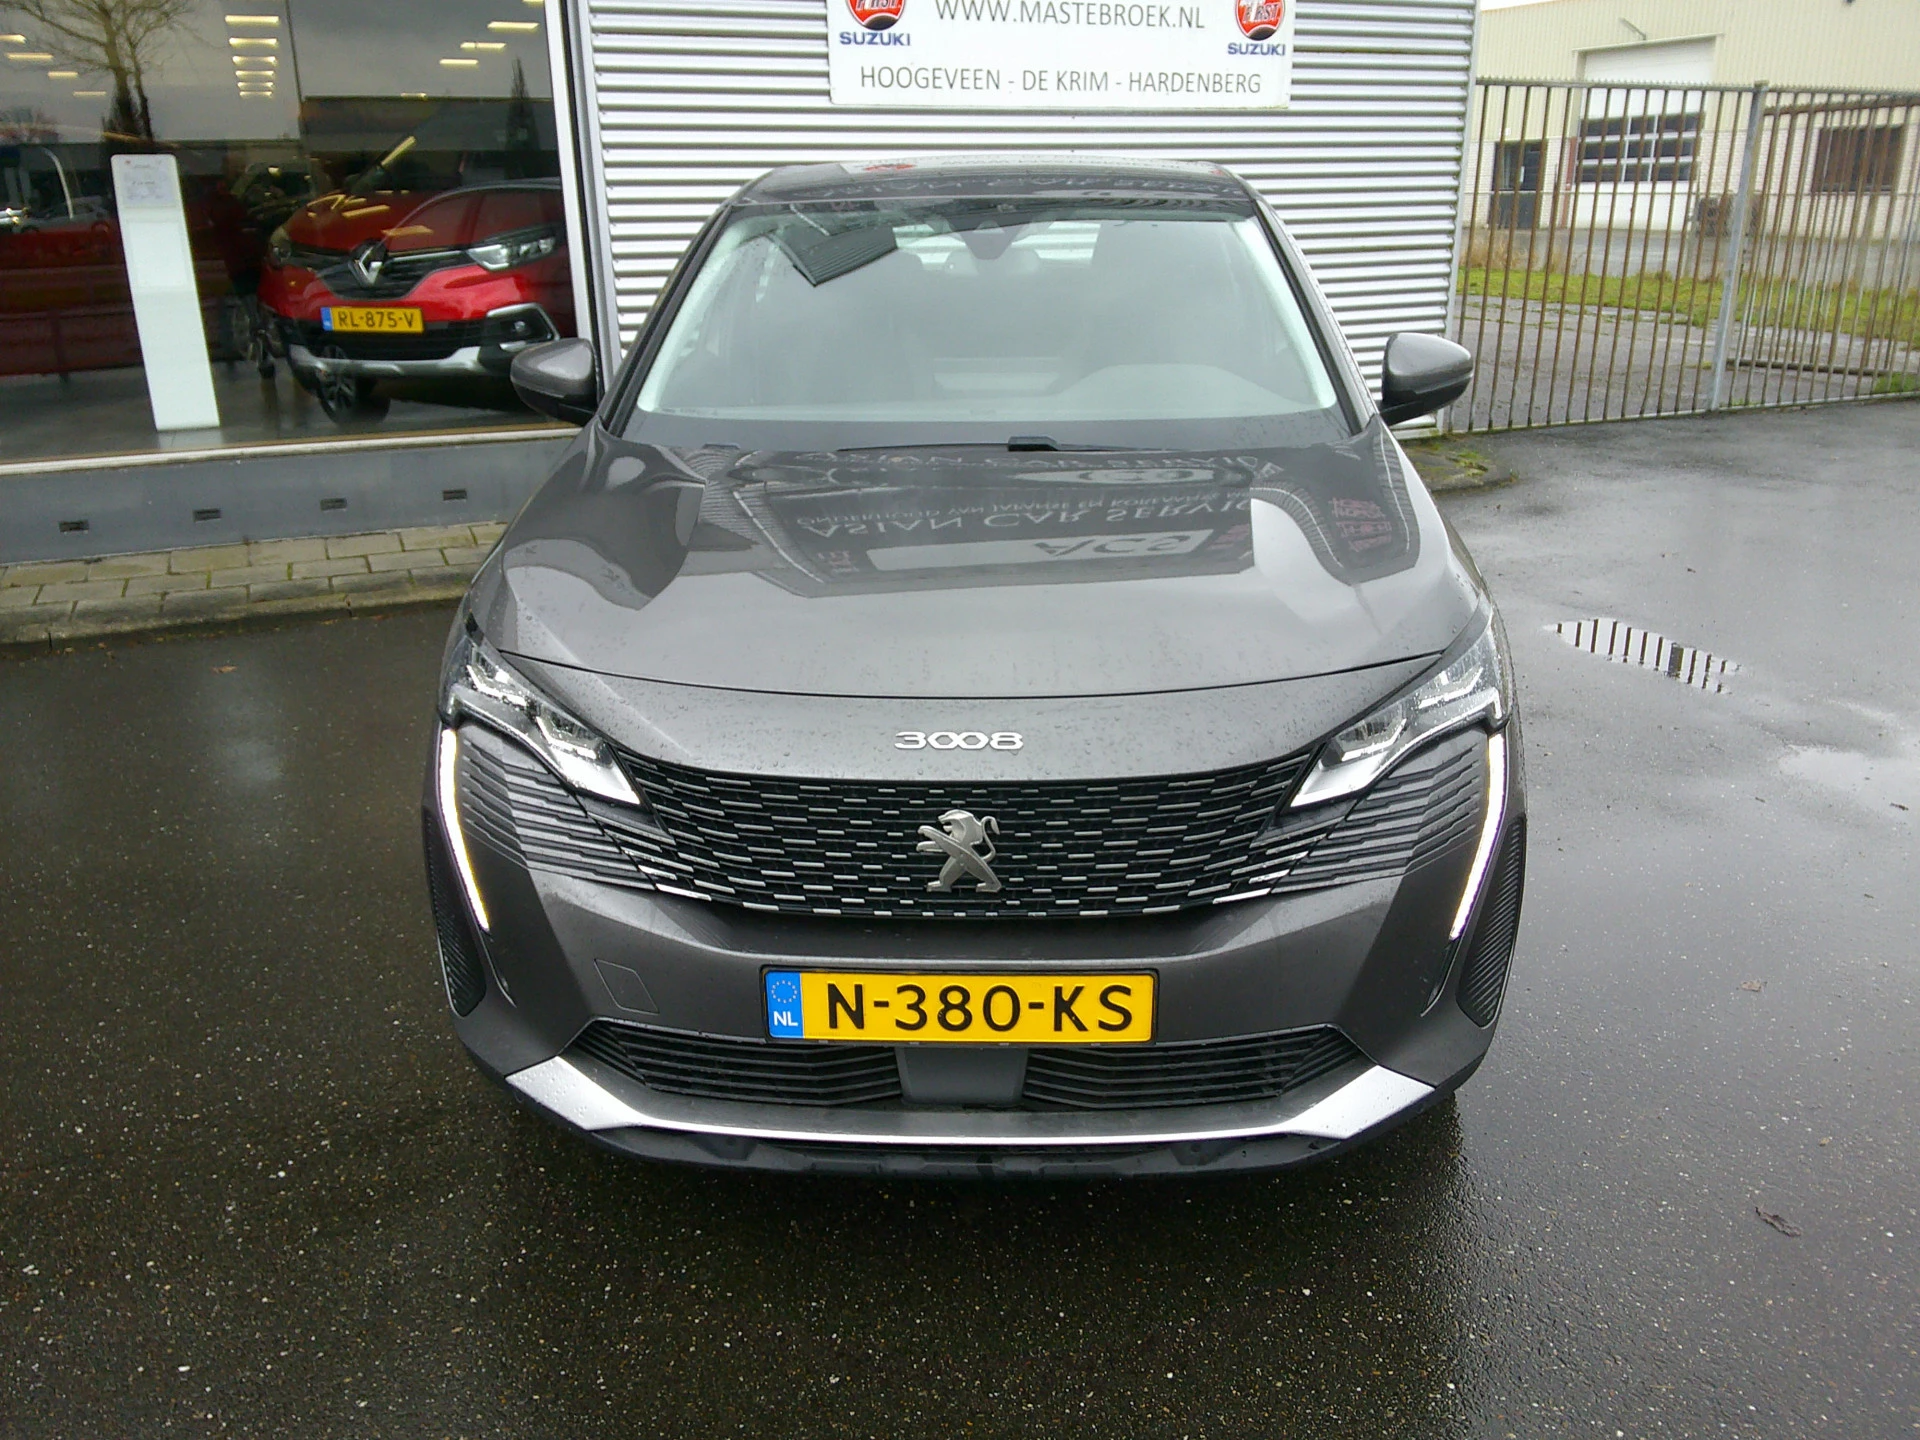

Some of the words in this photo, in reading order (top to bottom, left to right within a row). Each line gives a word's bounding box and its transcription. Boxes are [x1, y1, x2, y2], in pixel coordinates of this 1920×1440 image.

[935, 0, 1205, 28] WWW.MASTEBROEK.NL
[839, 31, 911, 46] SUZUKI
[1227, 42, 1286, 56] SUZUKI
[860, 66, 1000, 90] HOOGEVEEN
[1022, 70, 1048, 91] DE
[1056, 70, 1108, 91] KRIM
[1128, 72, 1262, 94] HARDENBERG
[337, 310, 414, 328] RL-875-V
[894, 731, 1024, 750] 3008
[826, 982, 1133, 1032] N-380-KS
[773, 1010, 798, 1027] NL
